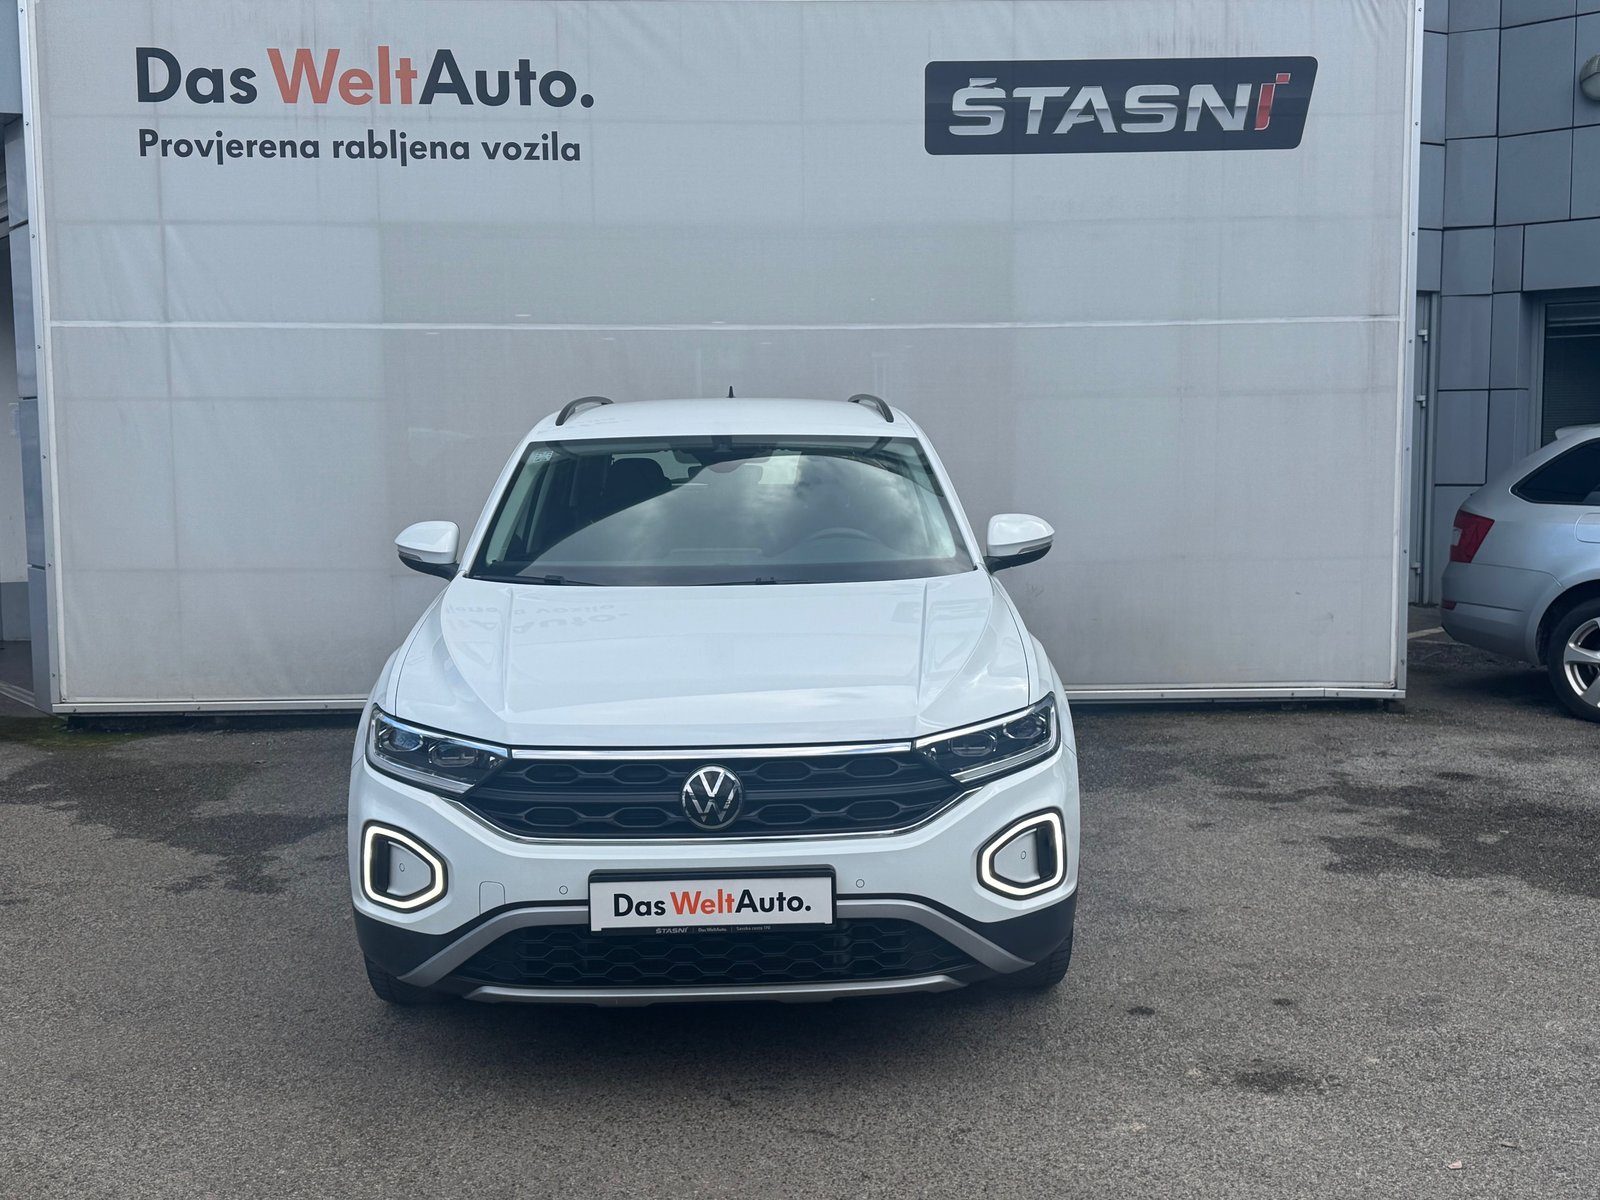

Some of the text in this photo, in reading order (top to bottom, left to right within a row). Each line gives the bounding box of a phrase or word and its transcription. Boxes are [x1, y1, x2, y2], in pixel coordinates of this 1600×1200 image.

[135, 45, 595, 108] Das WeltAuto.
[138, 128, 582, 167] Provjerena rabljena vozila
[613, 889, 812, 917] Das WeltAuto.
